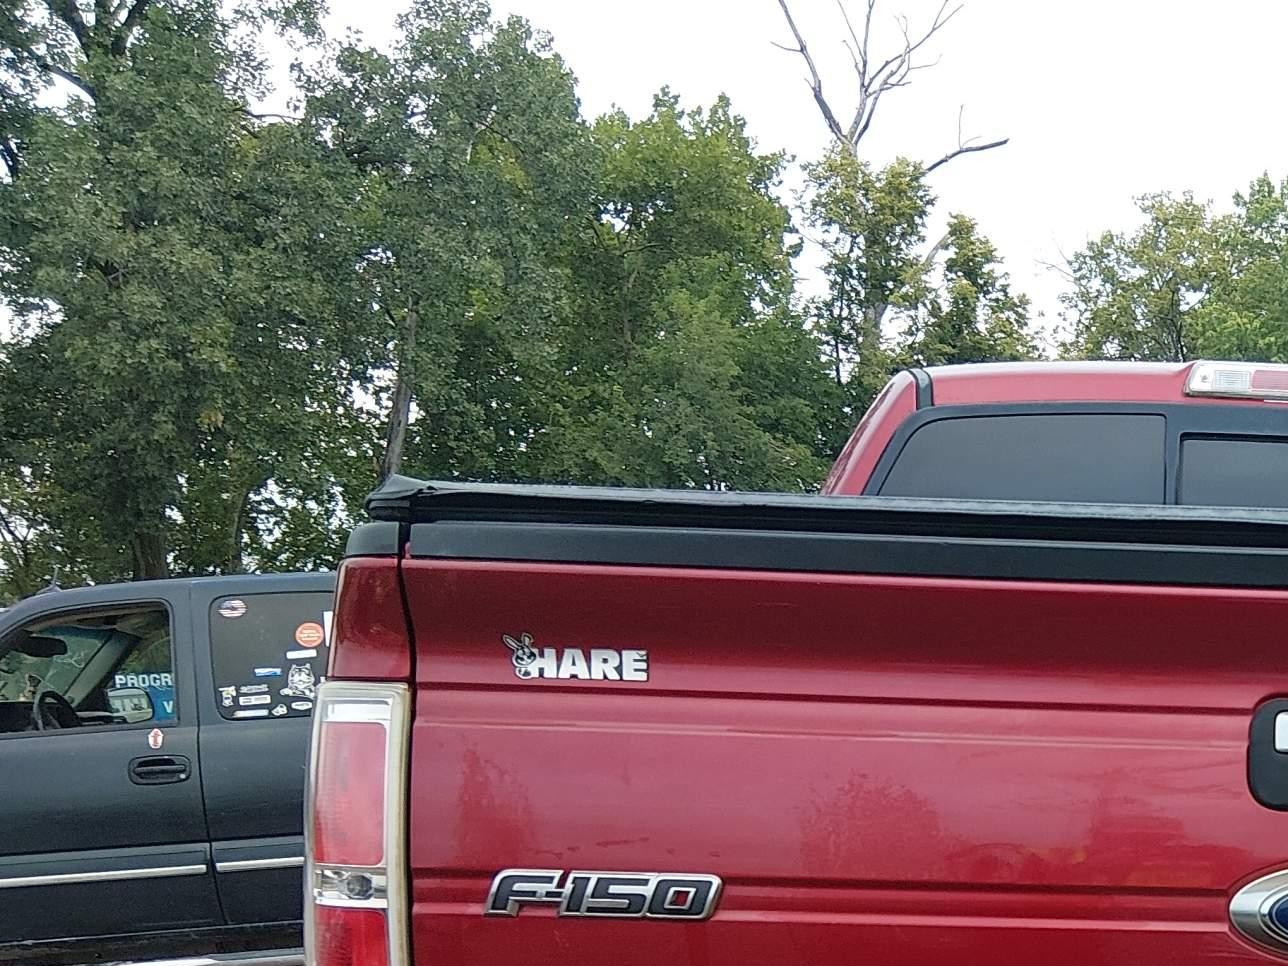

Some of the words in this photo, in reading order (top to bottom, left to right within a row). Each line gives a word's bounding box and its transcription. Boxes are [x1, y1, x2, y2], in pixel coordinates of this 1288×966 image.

[114, 673, 174, 688] PROGR
[529, 648, 648, 681] HARE
[483, 868, 723, 919] F-150
